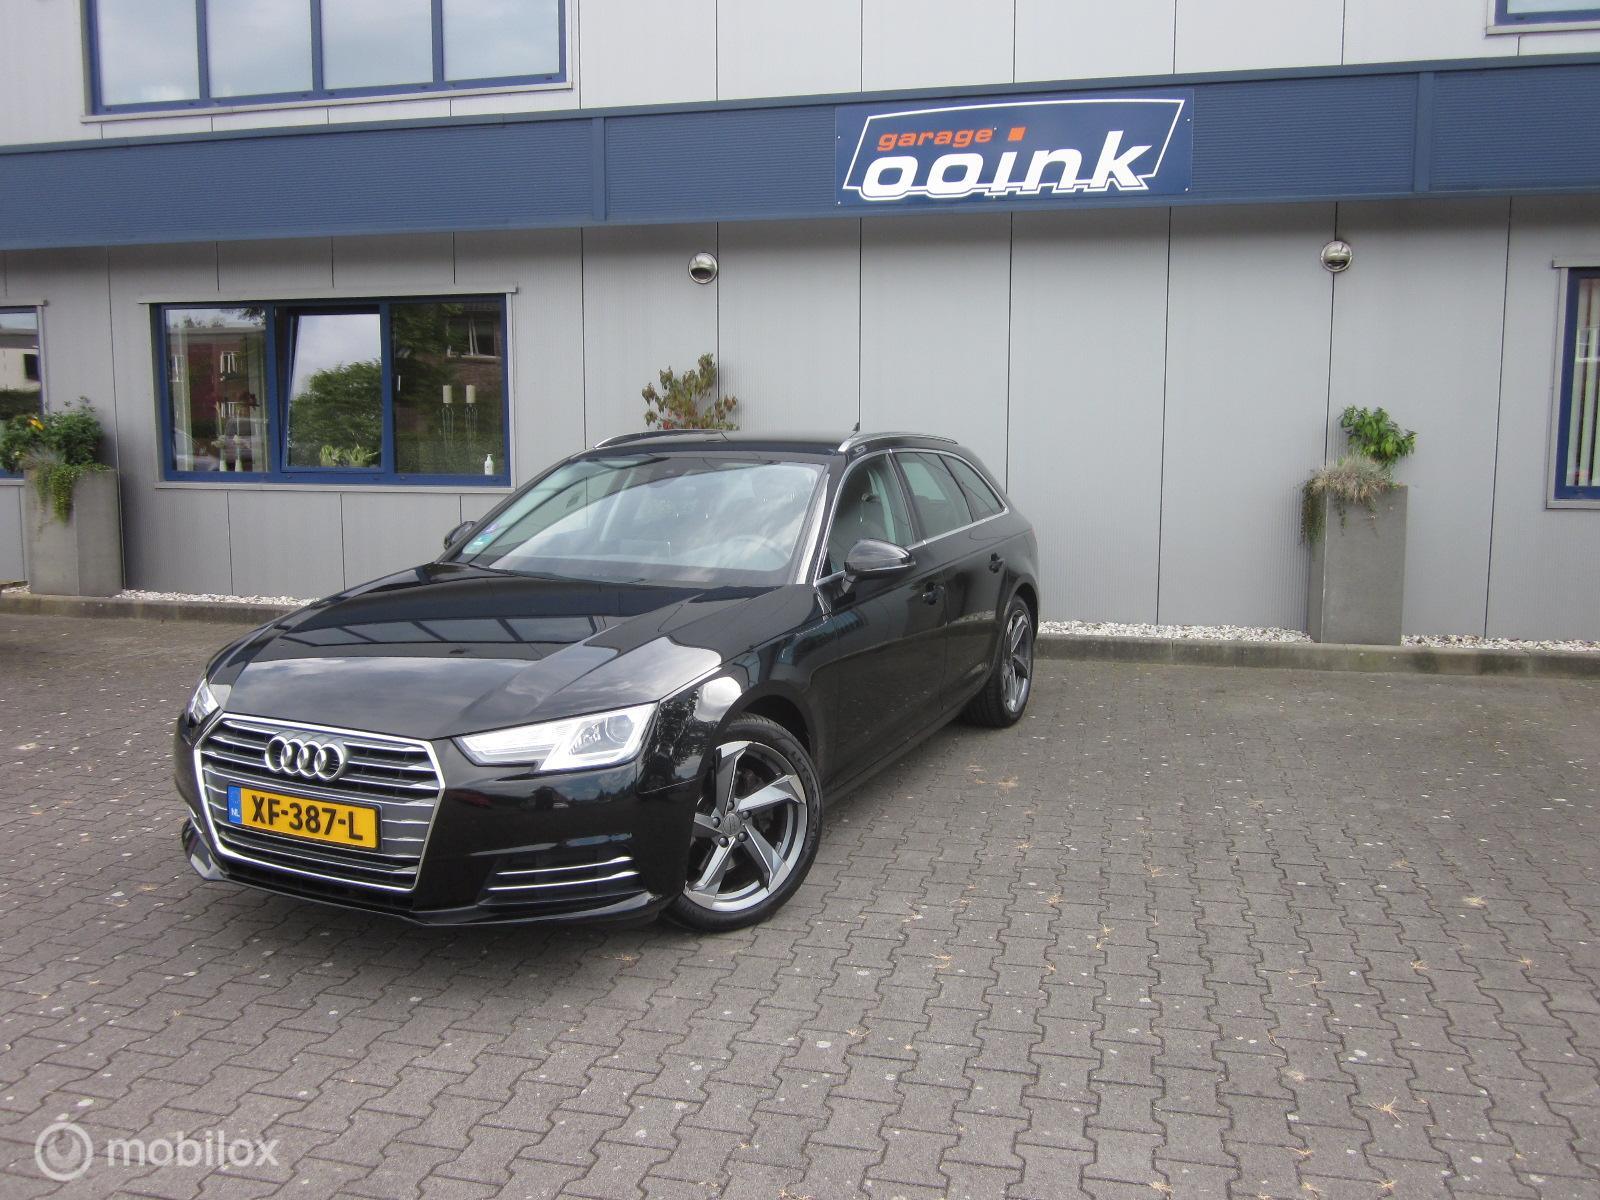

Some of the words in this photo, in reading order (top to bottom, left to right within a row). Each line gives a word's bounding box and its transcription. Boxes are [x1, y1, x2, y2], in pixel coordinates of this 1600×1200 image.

[877, 127, 994, 151] garage
[861, 127, 1153, 196] ooink
[231, 807, 240, 818] NL
[251, 795, 364, 841] XF-387-L
